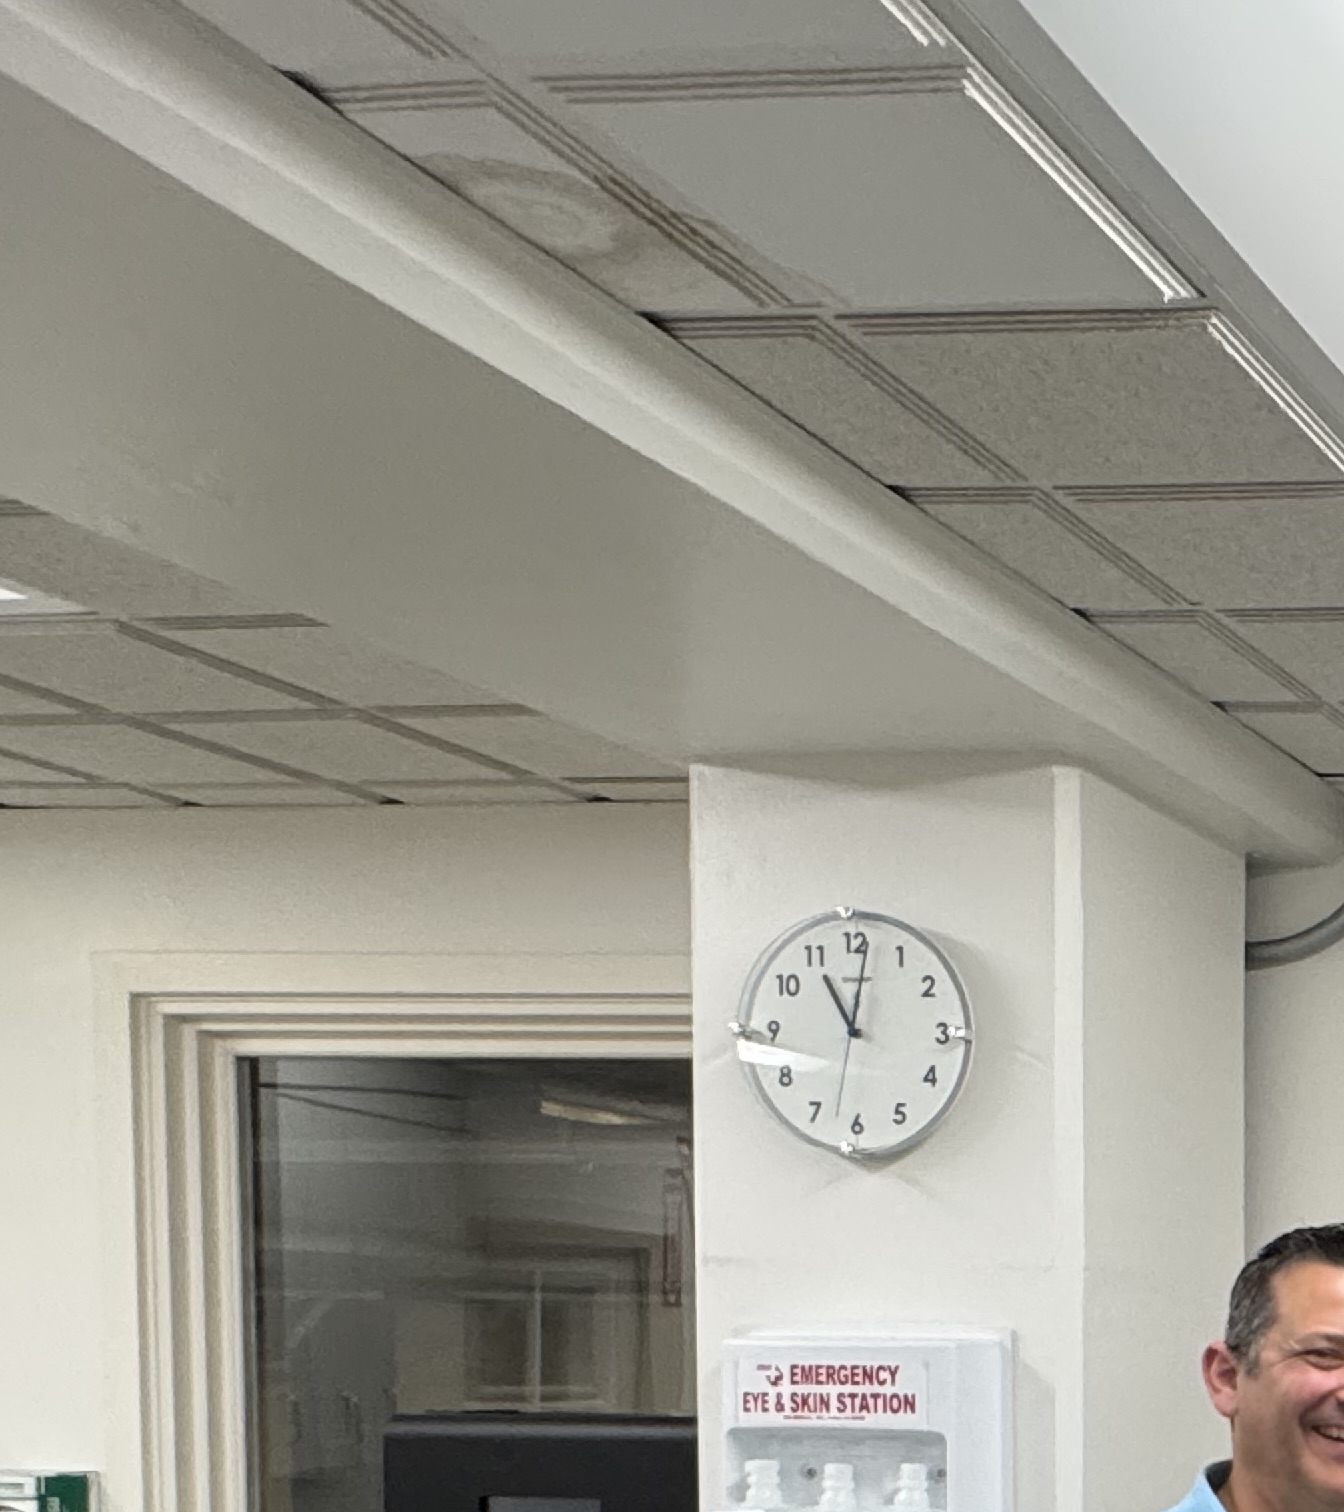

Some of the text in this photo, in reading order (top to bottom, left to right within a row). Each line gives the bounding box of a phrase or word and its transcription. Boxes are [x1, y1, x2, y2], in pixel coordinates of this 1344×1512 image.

[843, 932, 868, 954] 12
[804, 945, 825, 967] 11
[896, 945, 904, 967] 1
[776, 974, 800, 997] 10
[921, 975, 935, 997] 2
[767, 1020, 780, 1042] 9
[935, 1023, 949, 1045] 3
[778, 1065, 793, 1087] 8
[922, 1065, 937, 1087] 4
[809, 1101, 822, 1123] 7
[892, 1103, 907, 1124] 5
[851, 1113, 864, 1135] 6
[790, 1364, 899, 1386] EMERGENCY
[742, 1391, 916, 1414] EYE & SKIN STATION
